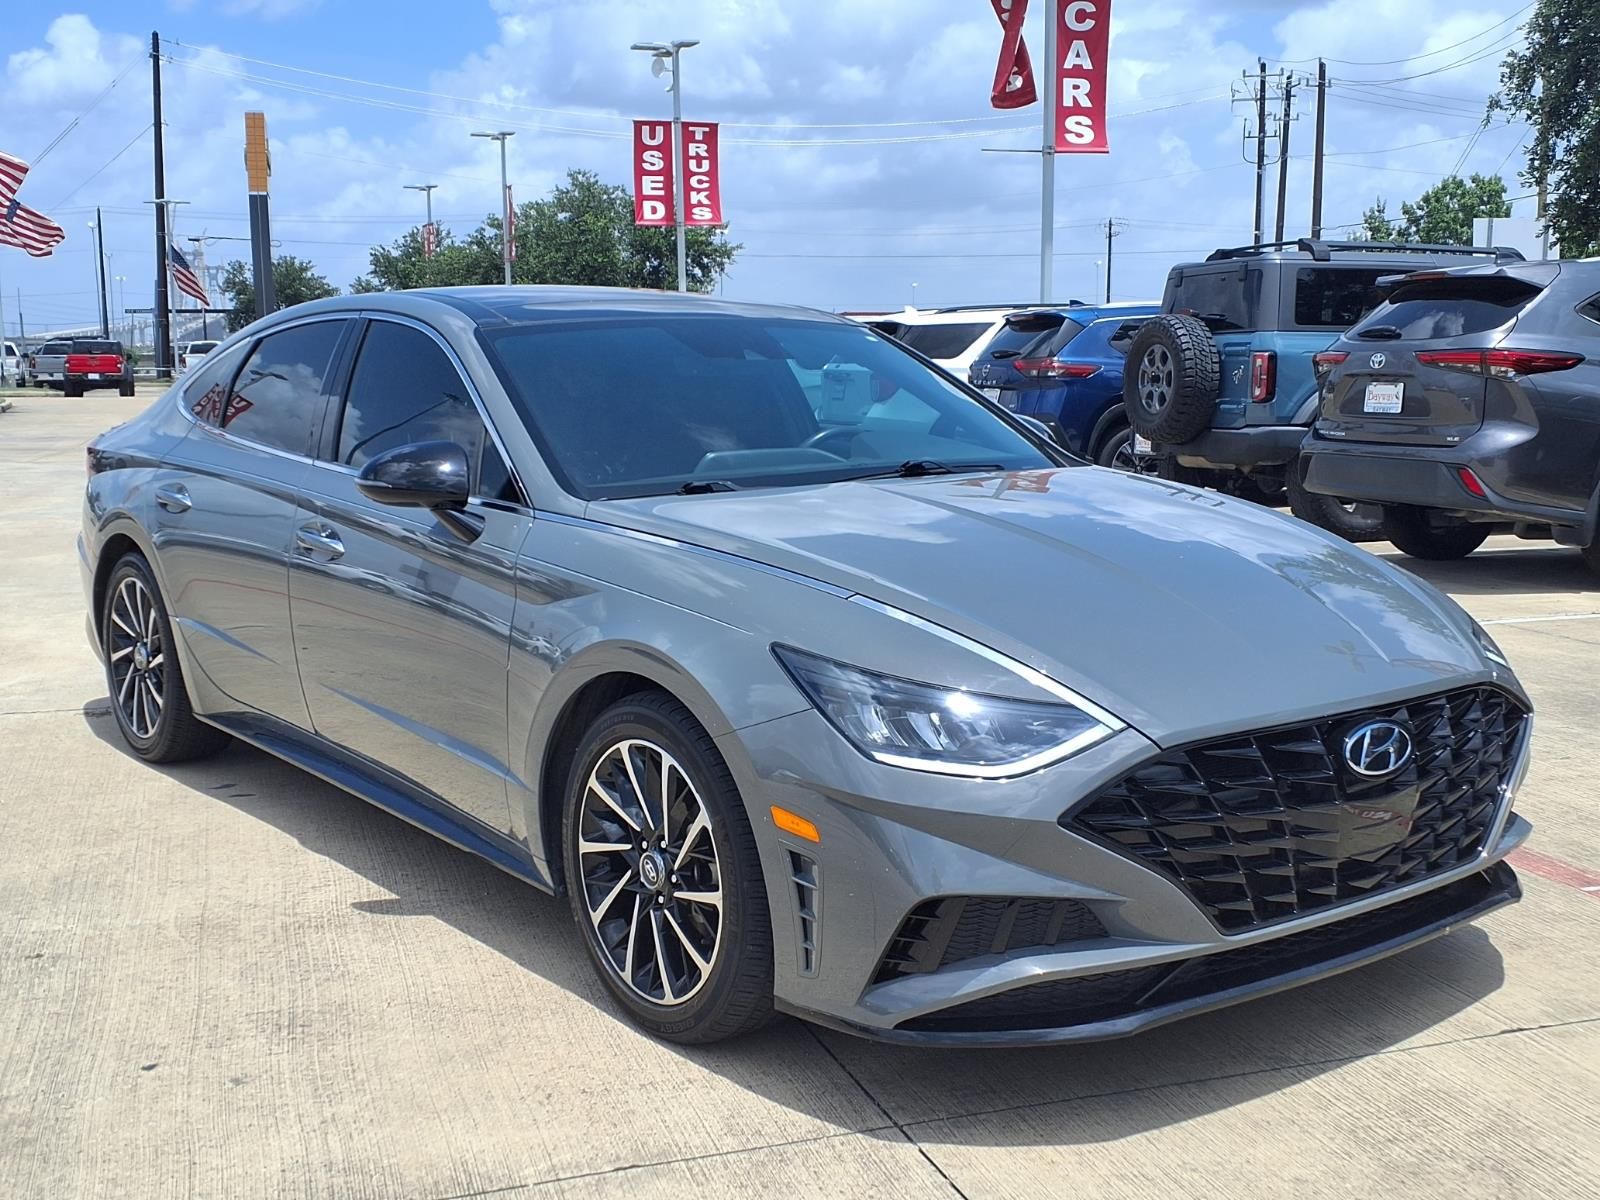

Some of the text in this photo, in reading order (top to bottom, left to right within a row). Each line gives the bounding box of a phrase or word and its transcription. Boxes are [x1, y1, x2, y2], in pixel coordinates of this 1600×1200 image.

[1062, 1, 1097, 144] CARS
[641, 125, 666, 220] USED
[688, 126, 713, 220] TRUCKS
